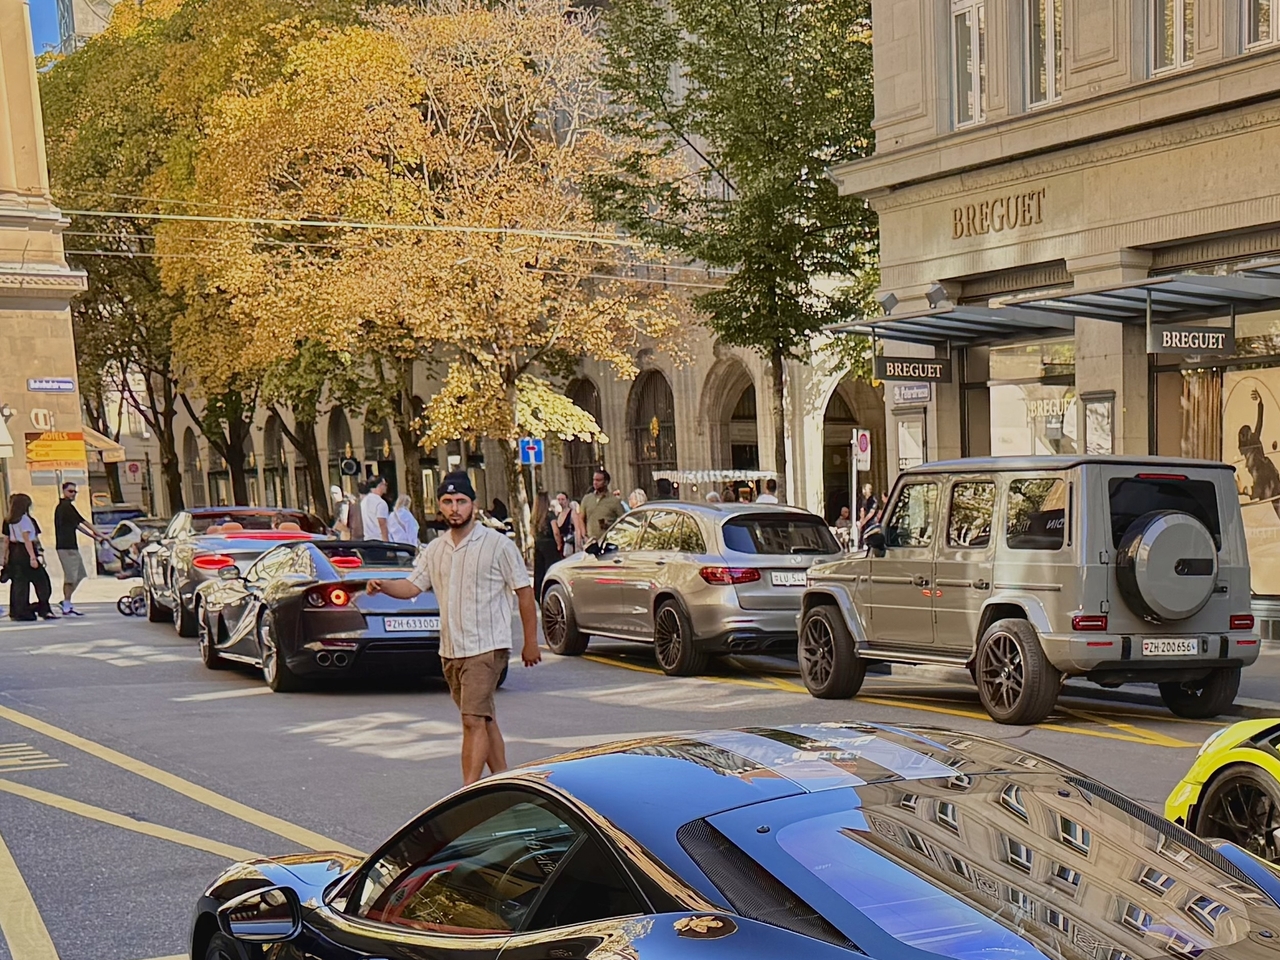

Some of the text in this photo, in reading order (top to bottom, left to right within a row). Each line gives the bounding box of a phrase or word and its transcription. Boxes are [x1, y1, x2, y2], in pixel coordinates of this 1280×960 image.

[951, 187, 1046, 240] BREGUET
[1162, 331, 1226, 349] BREGUET
[886, 362, 943, 378] BREGUET
